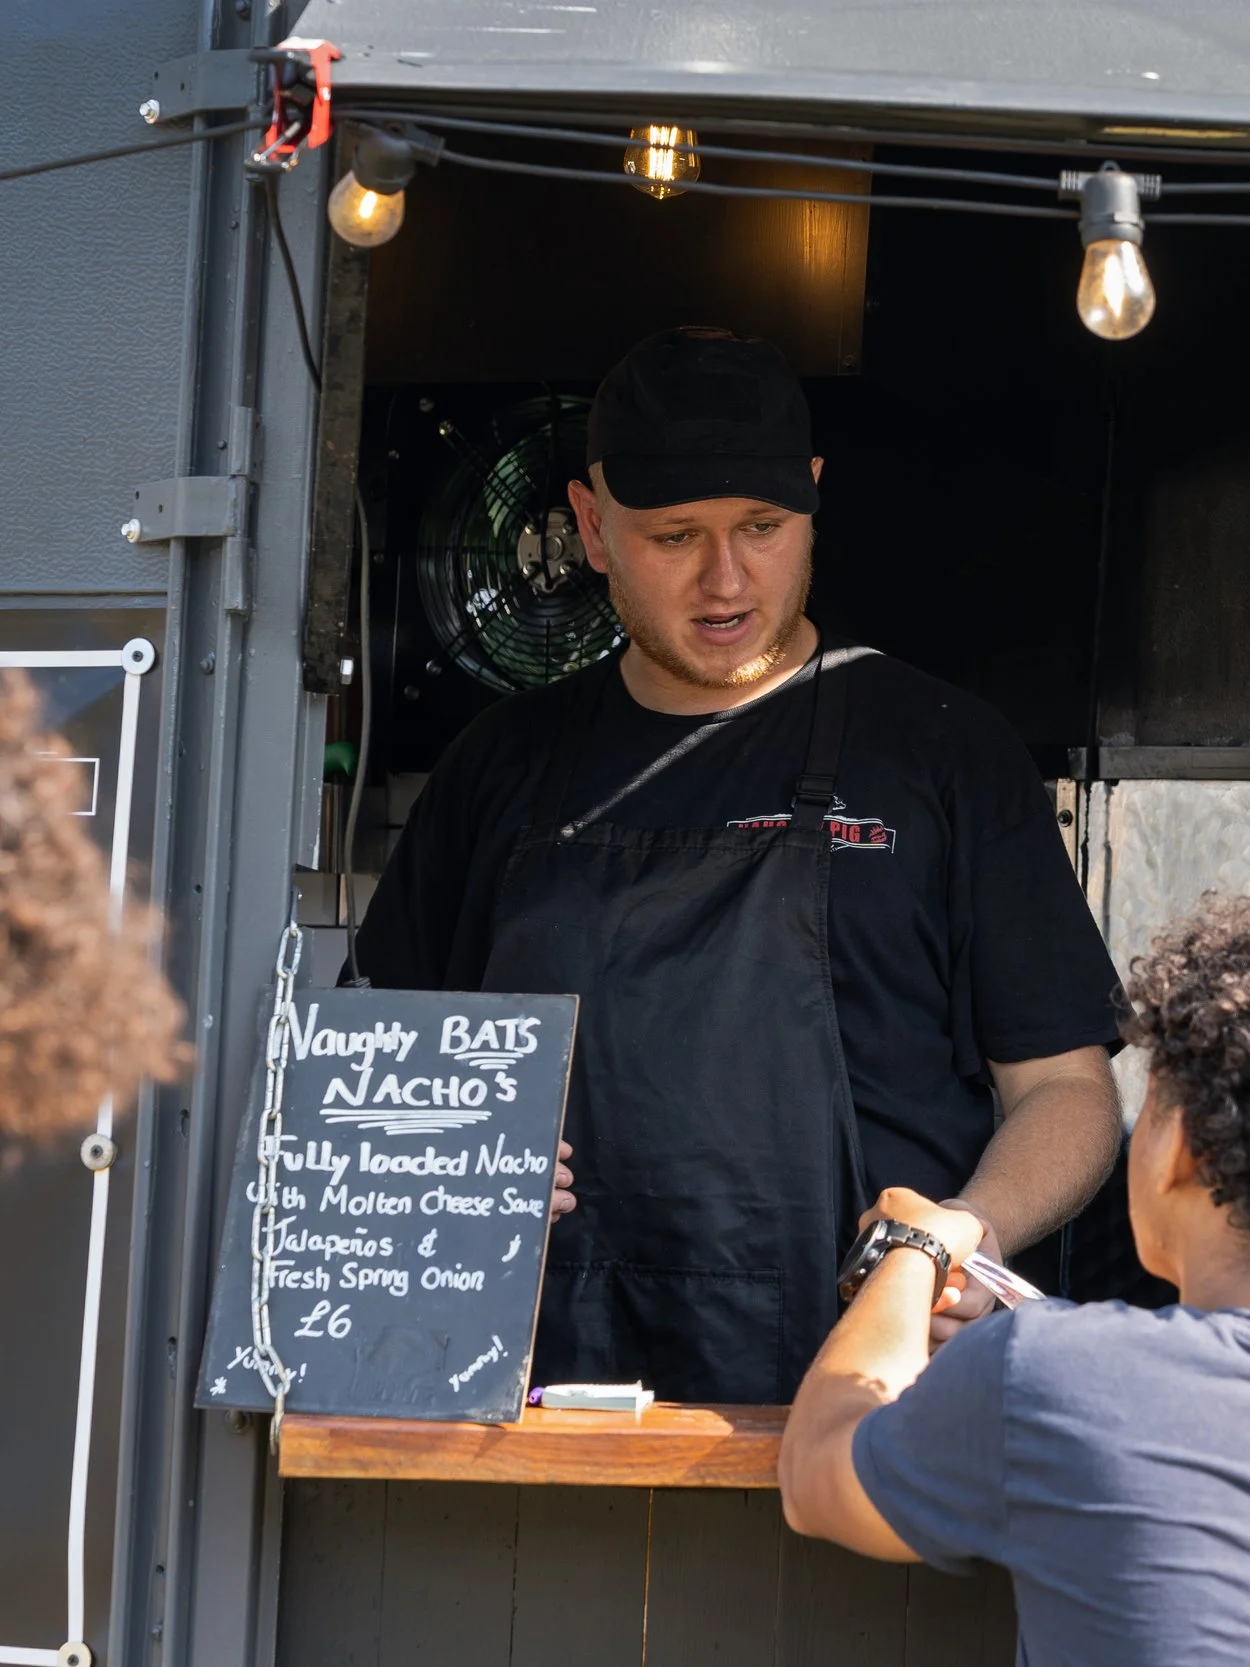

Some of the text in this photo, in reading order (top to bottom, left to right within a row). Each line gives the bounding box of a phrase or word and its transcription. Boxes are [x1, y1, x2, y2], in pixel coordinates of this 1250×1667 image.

[829, 820, 861, 843] PIG
[272, 1001, 541, 1072] Naughty BATS
[264, 1133, 549, 1186] Fully loaded Nacho
[319, 1184, 412, 1216] Molten
[417, 1228, 438, 1258] &
[268, 1260, 485, 1297] Fresh Spring Onion
[294, 1300, 352, 1338] £6
